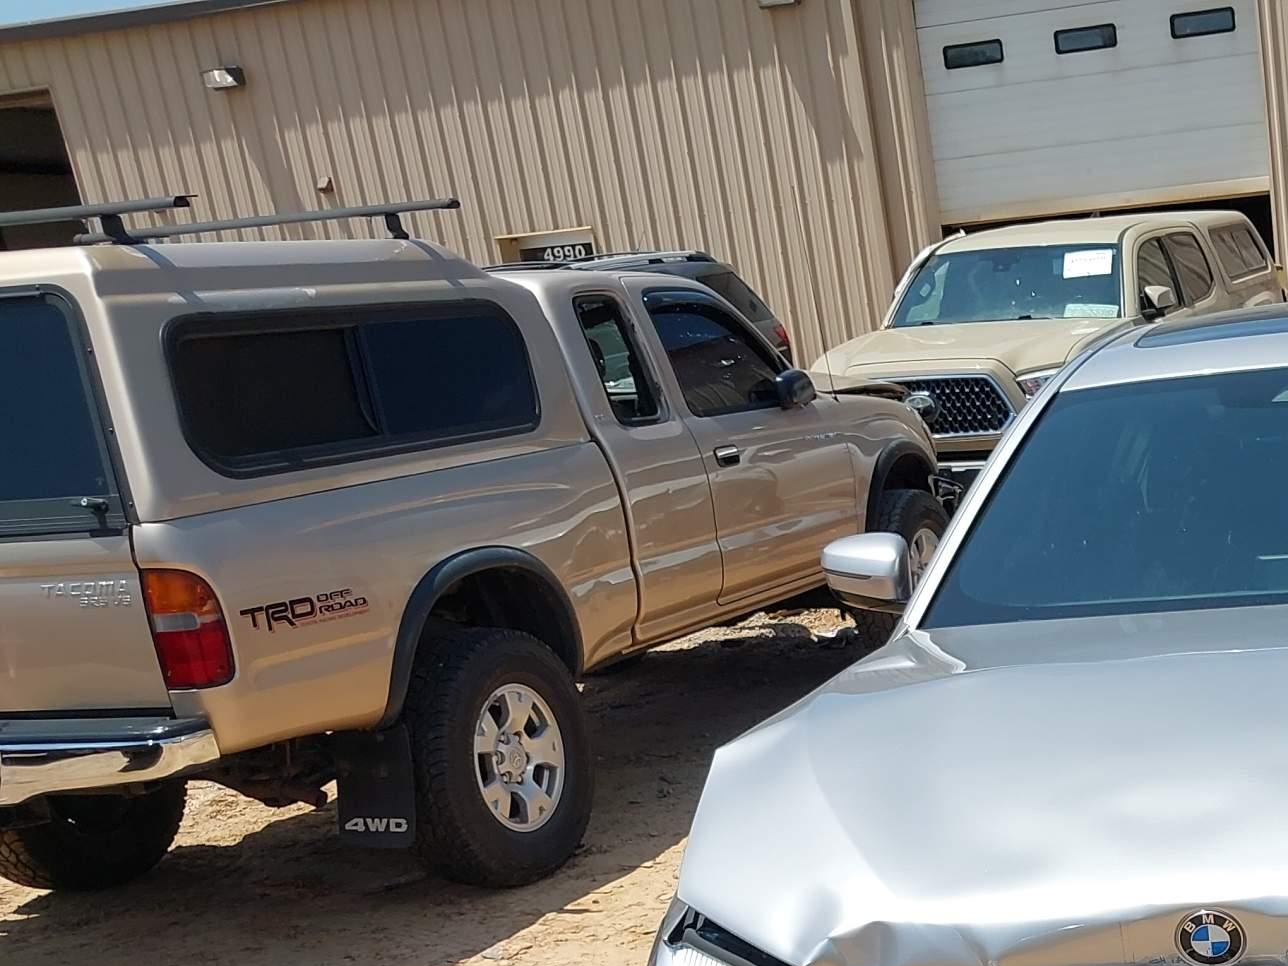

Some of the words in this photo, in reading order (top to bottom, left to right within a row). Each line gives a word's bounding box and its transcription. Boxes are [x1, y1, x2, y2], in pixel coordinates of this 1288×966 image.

[544, 245, 586, 261] 4990
[40, 580, 128, 598] TACOMA
[317, 588, 352, 602] OFF
[319, 597, 368, 614] ROAD
[240, 597, 316, 632] TRD
[345, 817, 408, 832] 4WD
[1183, 914, 1236, 933] BMW
